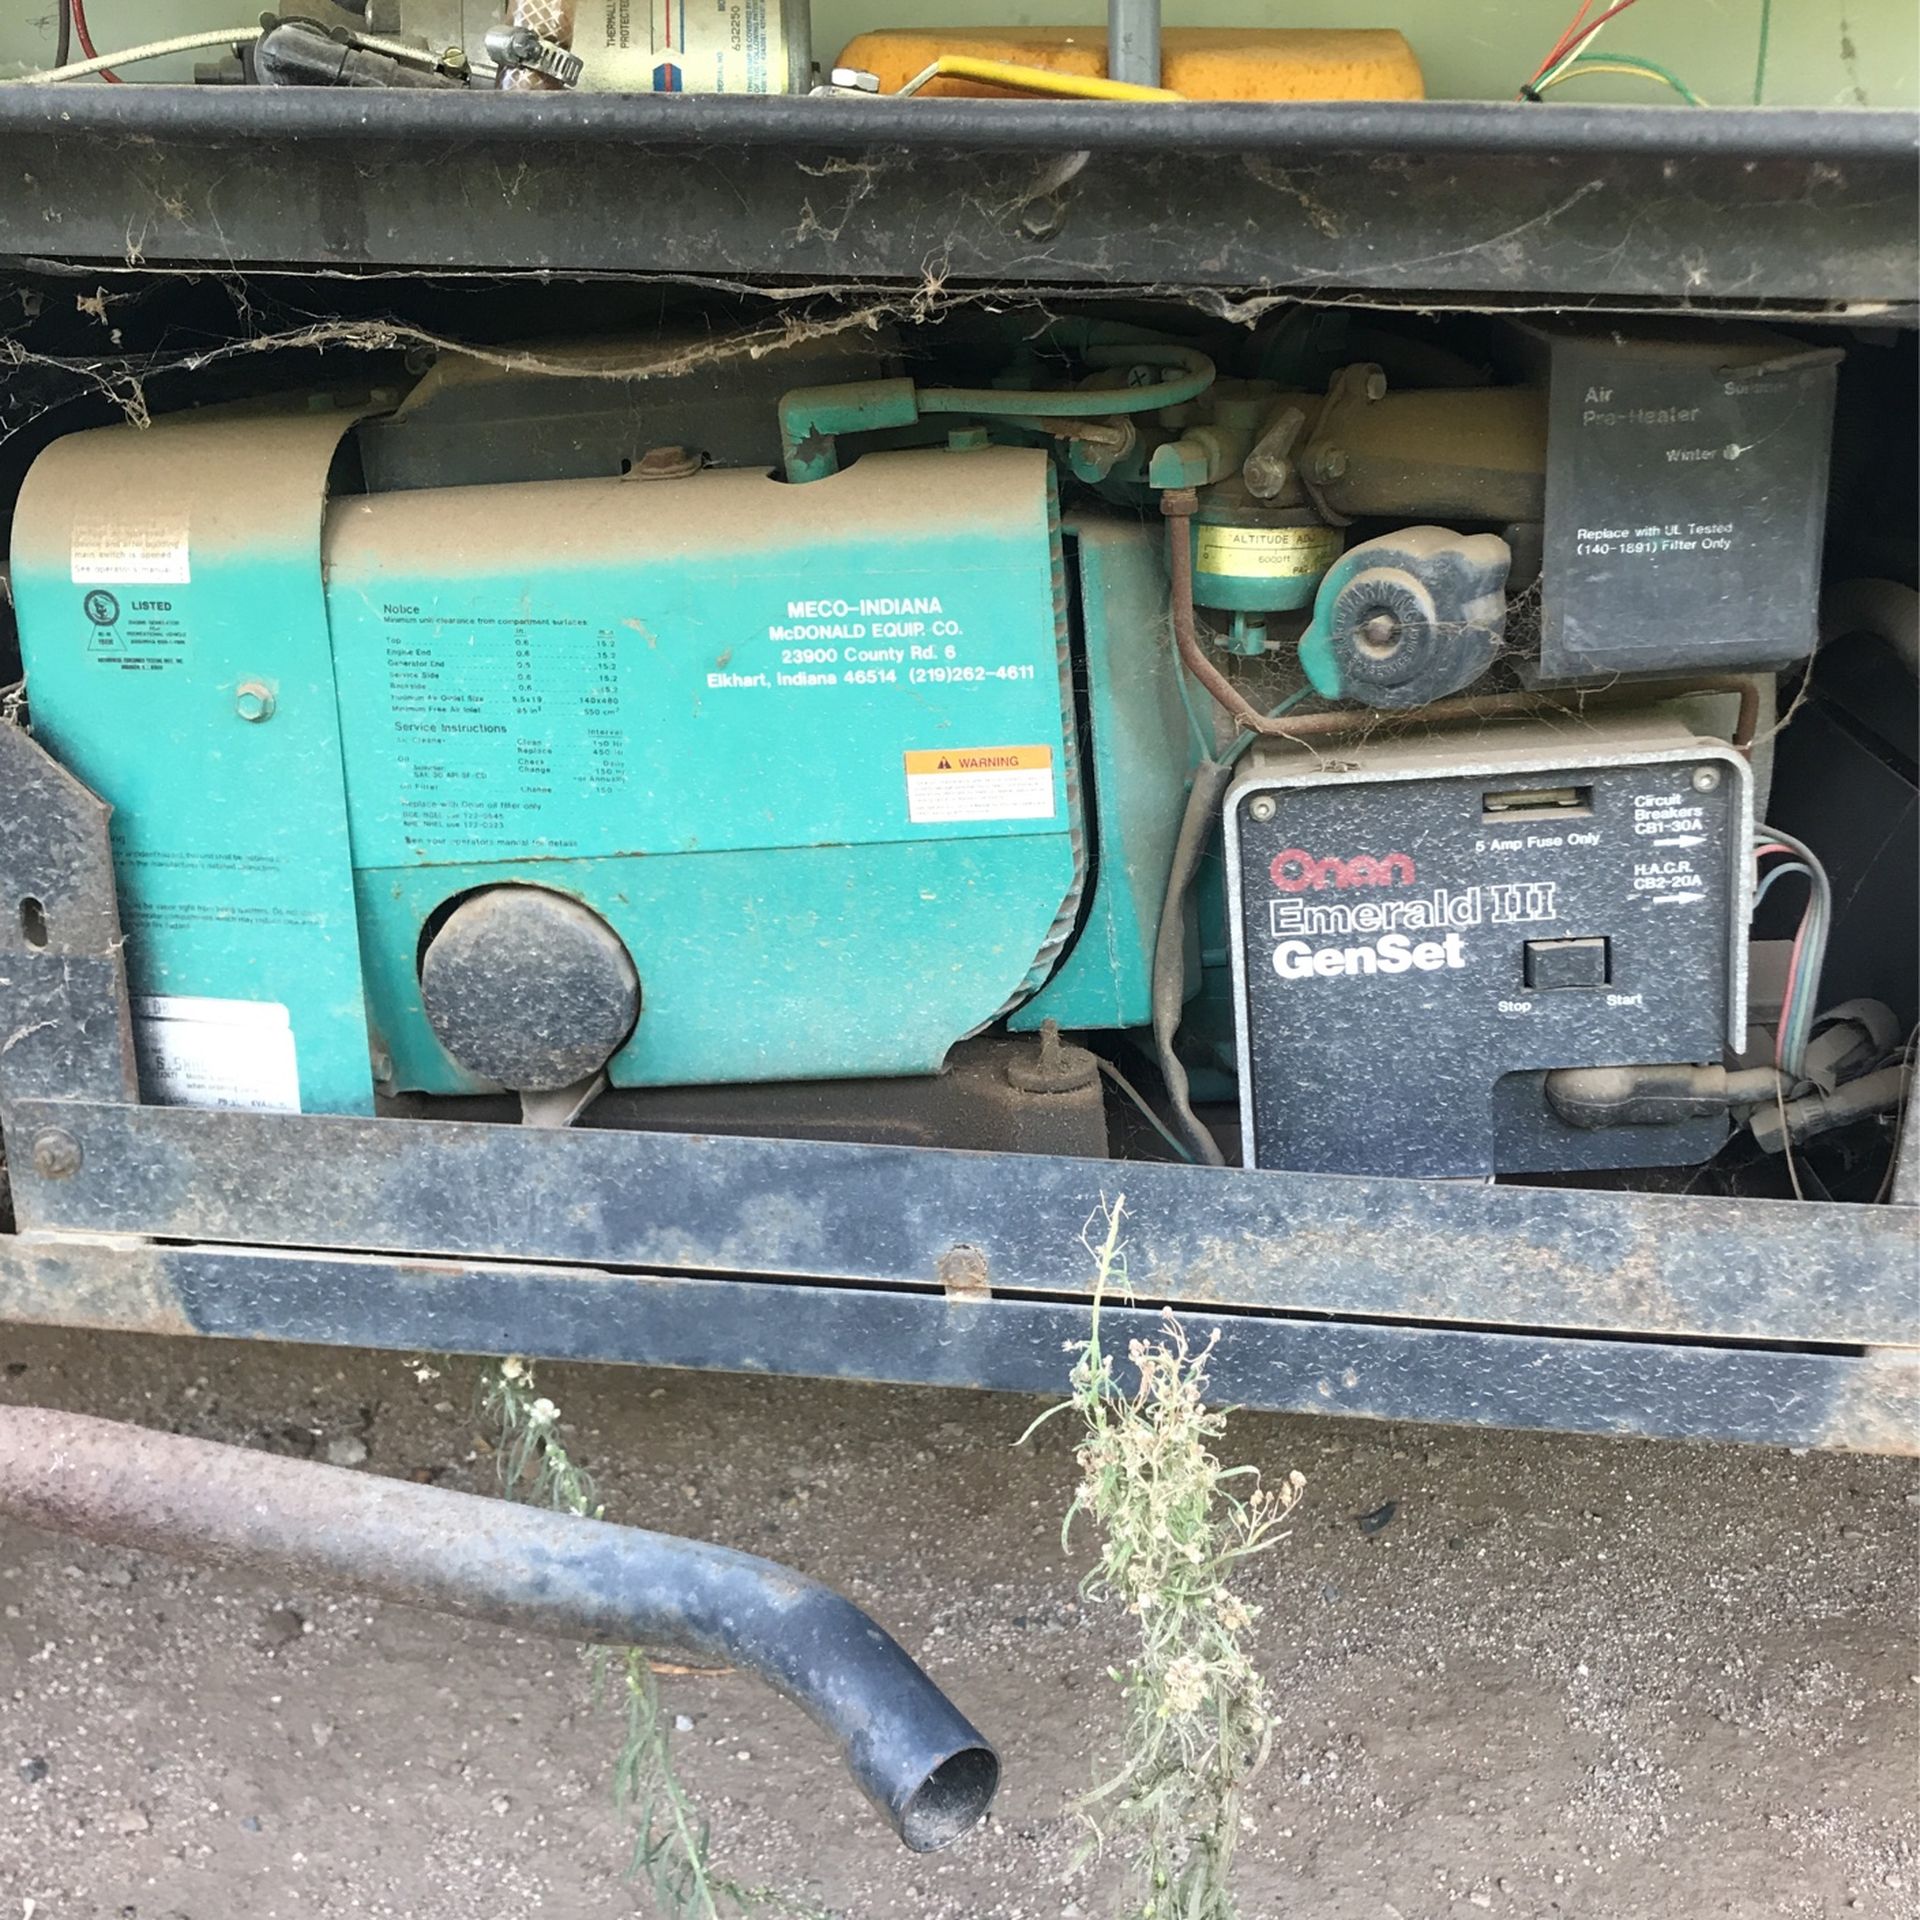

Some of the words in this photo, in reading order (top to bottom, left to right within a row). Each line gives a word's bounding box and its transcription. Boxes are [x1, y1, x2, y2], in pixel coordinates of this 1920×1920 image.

[606, 0, 616, 47] THERMALL
[730, 4, 741, 51] 632250
[1584, 386, 1614, 403] Air
[1666, 448, 1717, 462] Winter
[1233, 534, 1289, 544] ALTITUDE
[1577, 528, 1630, 541] Replace
[1635, 526, 1661, 538] with
[1664, 525, 1682, 536] UL
[1688, 523, 1733, 535] Tested
[1577, 542, 1658, 556] (140-1891)
[1662, 539, 1697, 551] Filter
[1701, 538, 1732, 551] Only
[131, 600, 172, 611] LISTED
[384, 603, 420, 615] Notice
[787, 597, 943, 619] MECO-INDIANA
[769, 623, 866, 642] McDONALD
[872, 622, 926, 639] EQUIP.
[933, 620, 964, 637] CO.
[781, 649, 838, 665] 23900
[844, 648, 904, 664] County
[910, 645, 938, 660] Rd.
[945, 645, 956, 660] 6
[707, 671, 772, 689] Elkhart,
[777, 670, 837, 687] Indiana
[843, 669, 897, 685] 46514
[909, 664, 1035, 685] (219)262-4611
[394, 721, 437, 733] Service
[441, 723, 508, 734] Instructions
[958, 756, 1019, 769] WARNING
[1634, 793, 1682, 808] Circuit
[1634, 807, 1703, 822] Breakers
[1634, 820, 1703, 835] CB1-30A
[1475, 841, 1486, 852] 5
[1490, 838, 1523, 853] Amp
[1527, 836, 1562, 849] Fuse
[1567, 833, 1601, 848] Only
[1270, 848, 1416, 893] Onan
[1634, 861, 1694, 876] H.A.C.R.
[1634, 875, 1703, 890] CB2-20A
[1270, 888, 1482, 937] Emerald
[1491, 882, 1557, 923] III
[1272, 932, 1466, 979] GenSet
[1498, 998, 1532, 1014] Stop
[1606, 992, 1643, 1006] Start
